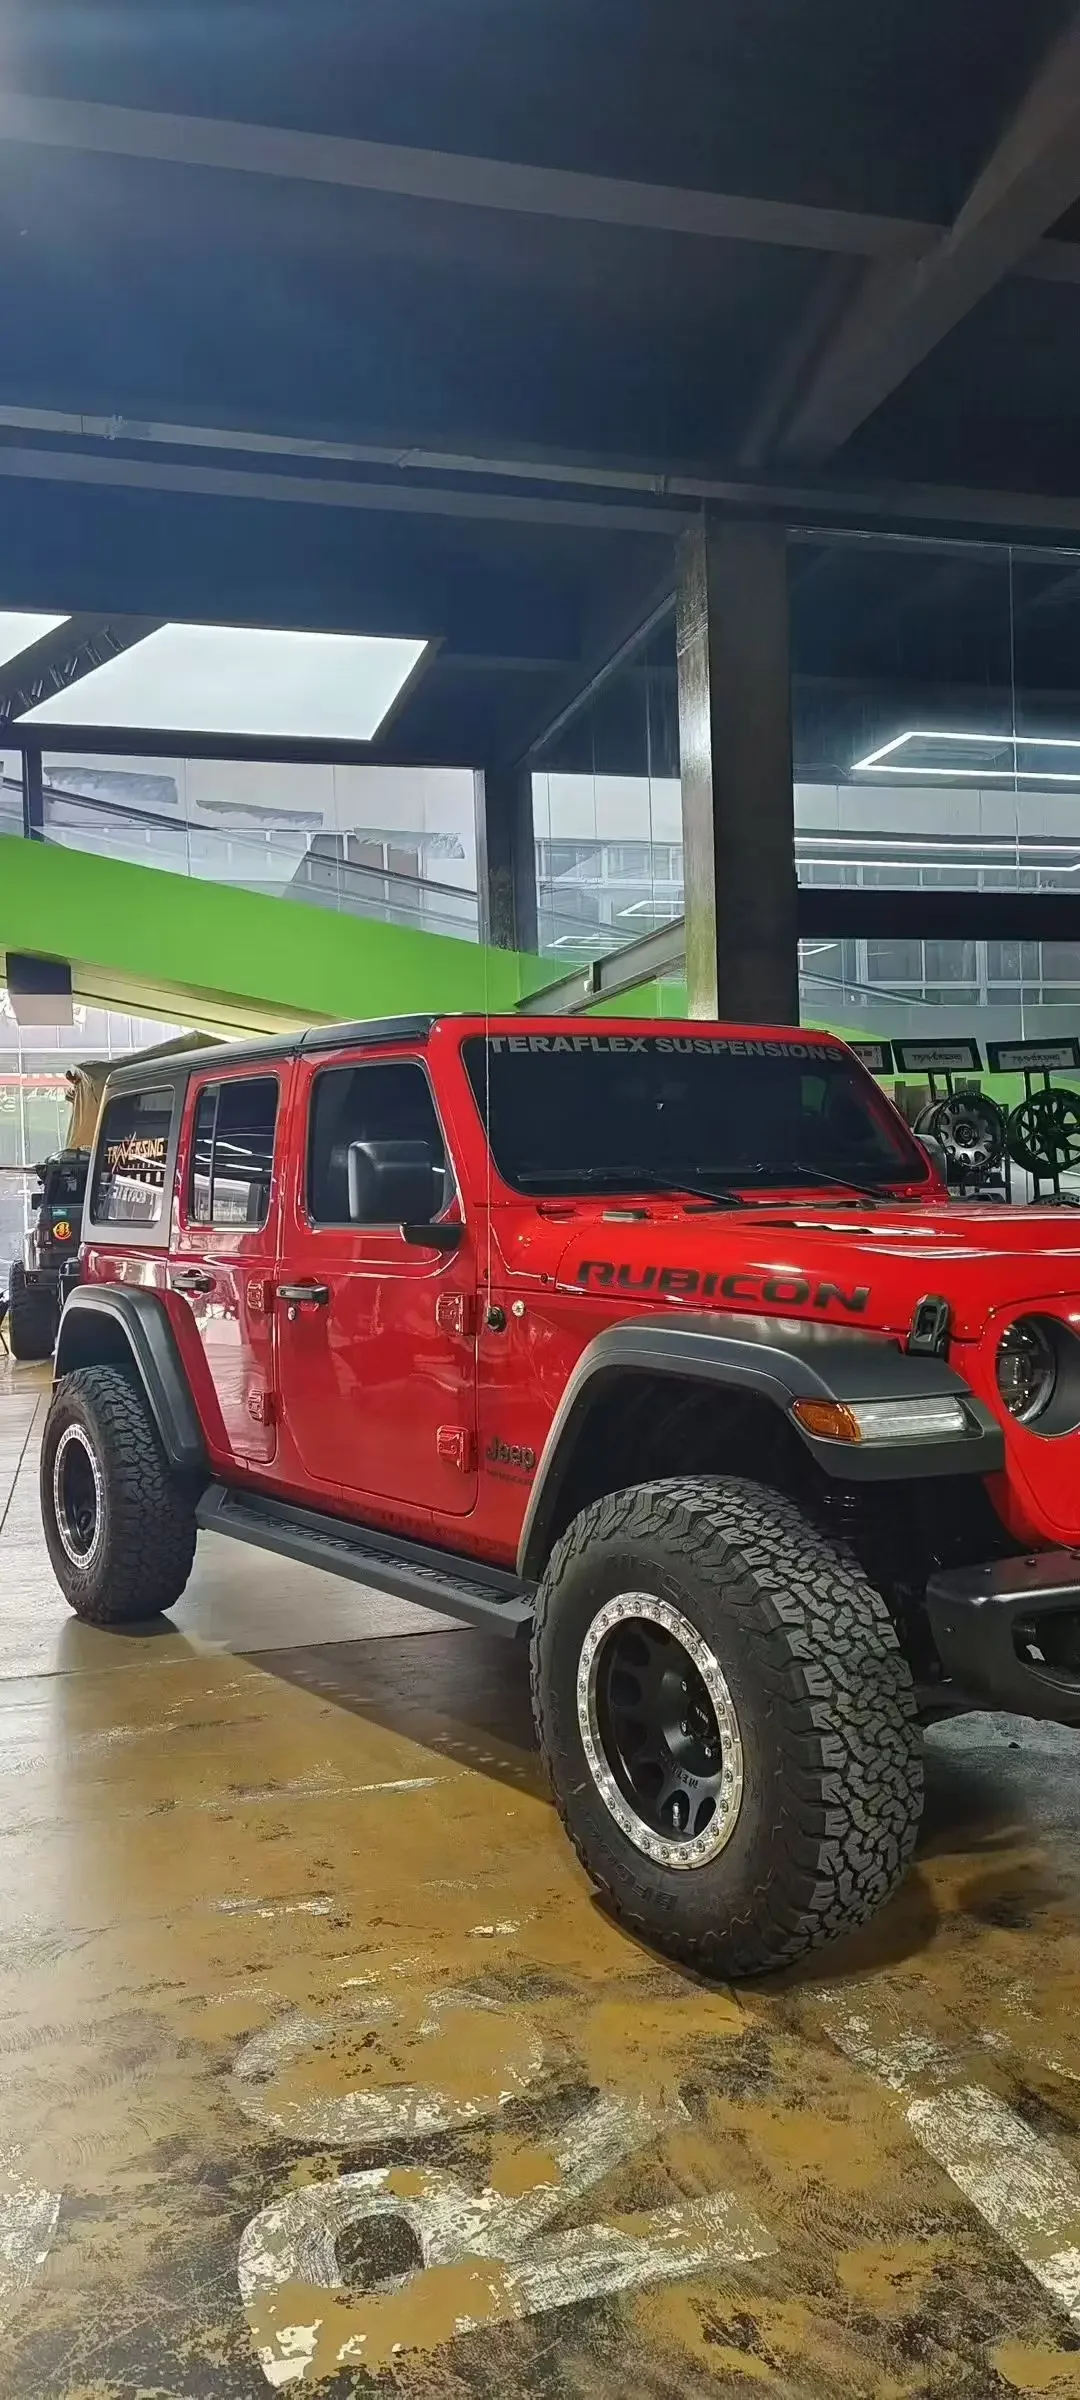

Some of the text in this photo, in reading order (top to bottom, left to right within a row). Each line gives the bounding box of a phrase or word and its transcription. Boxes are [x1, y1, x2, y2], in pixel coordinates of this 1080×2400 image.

[489, 1035, 649, 1053] TERAFLEX
[654, 1036, 844, 1062] SUSPENSIONS
[577, 1260, 871, 1313] RUBICON
[486, 1436, 536, 1472] Jeep
